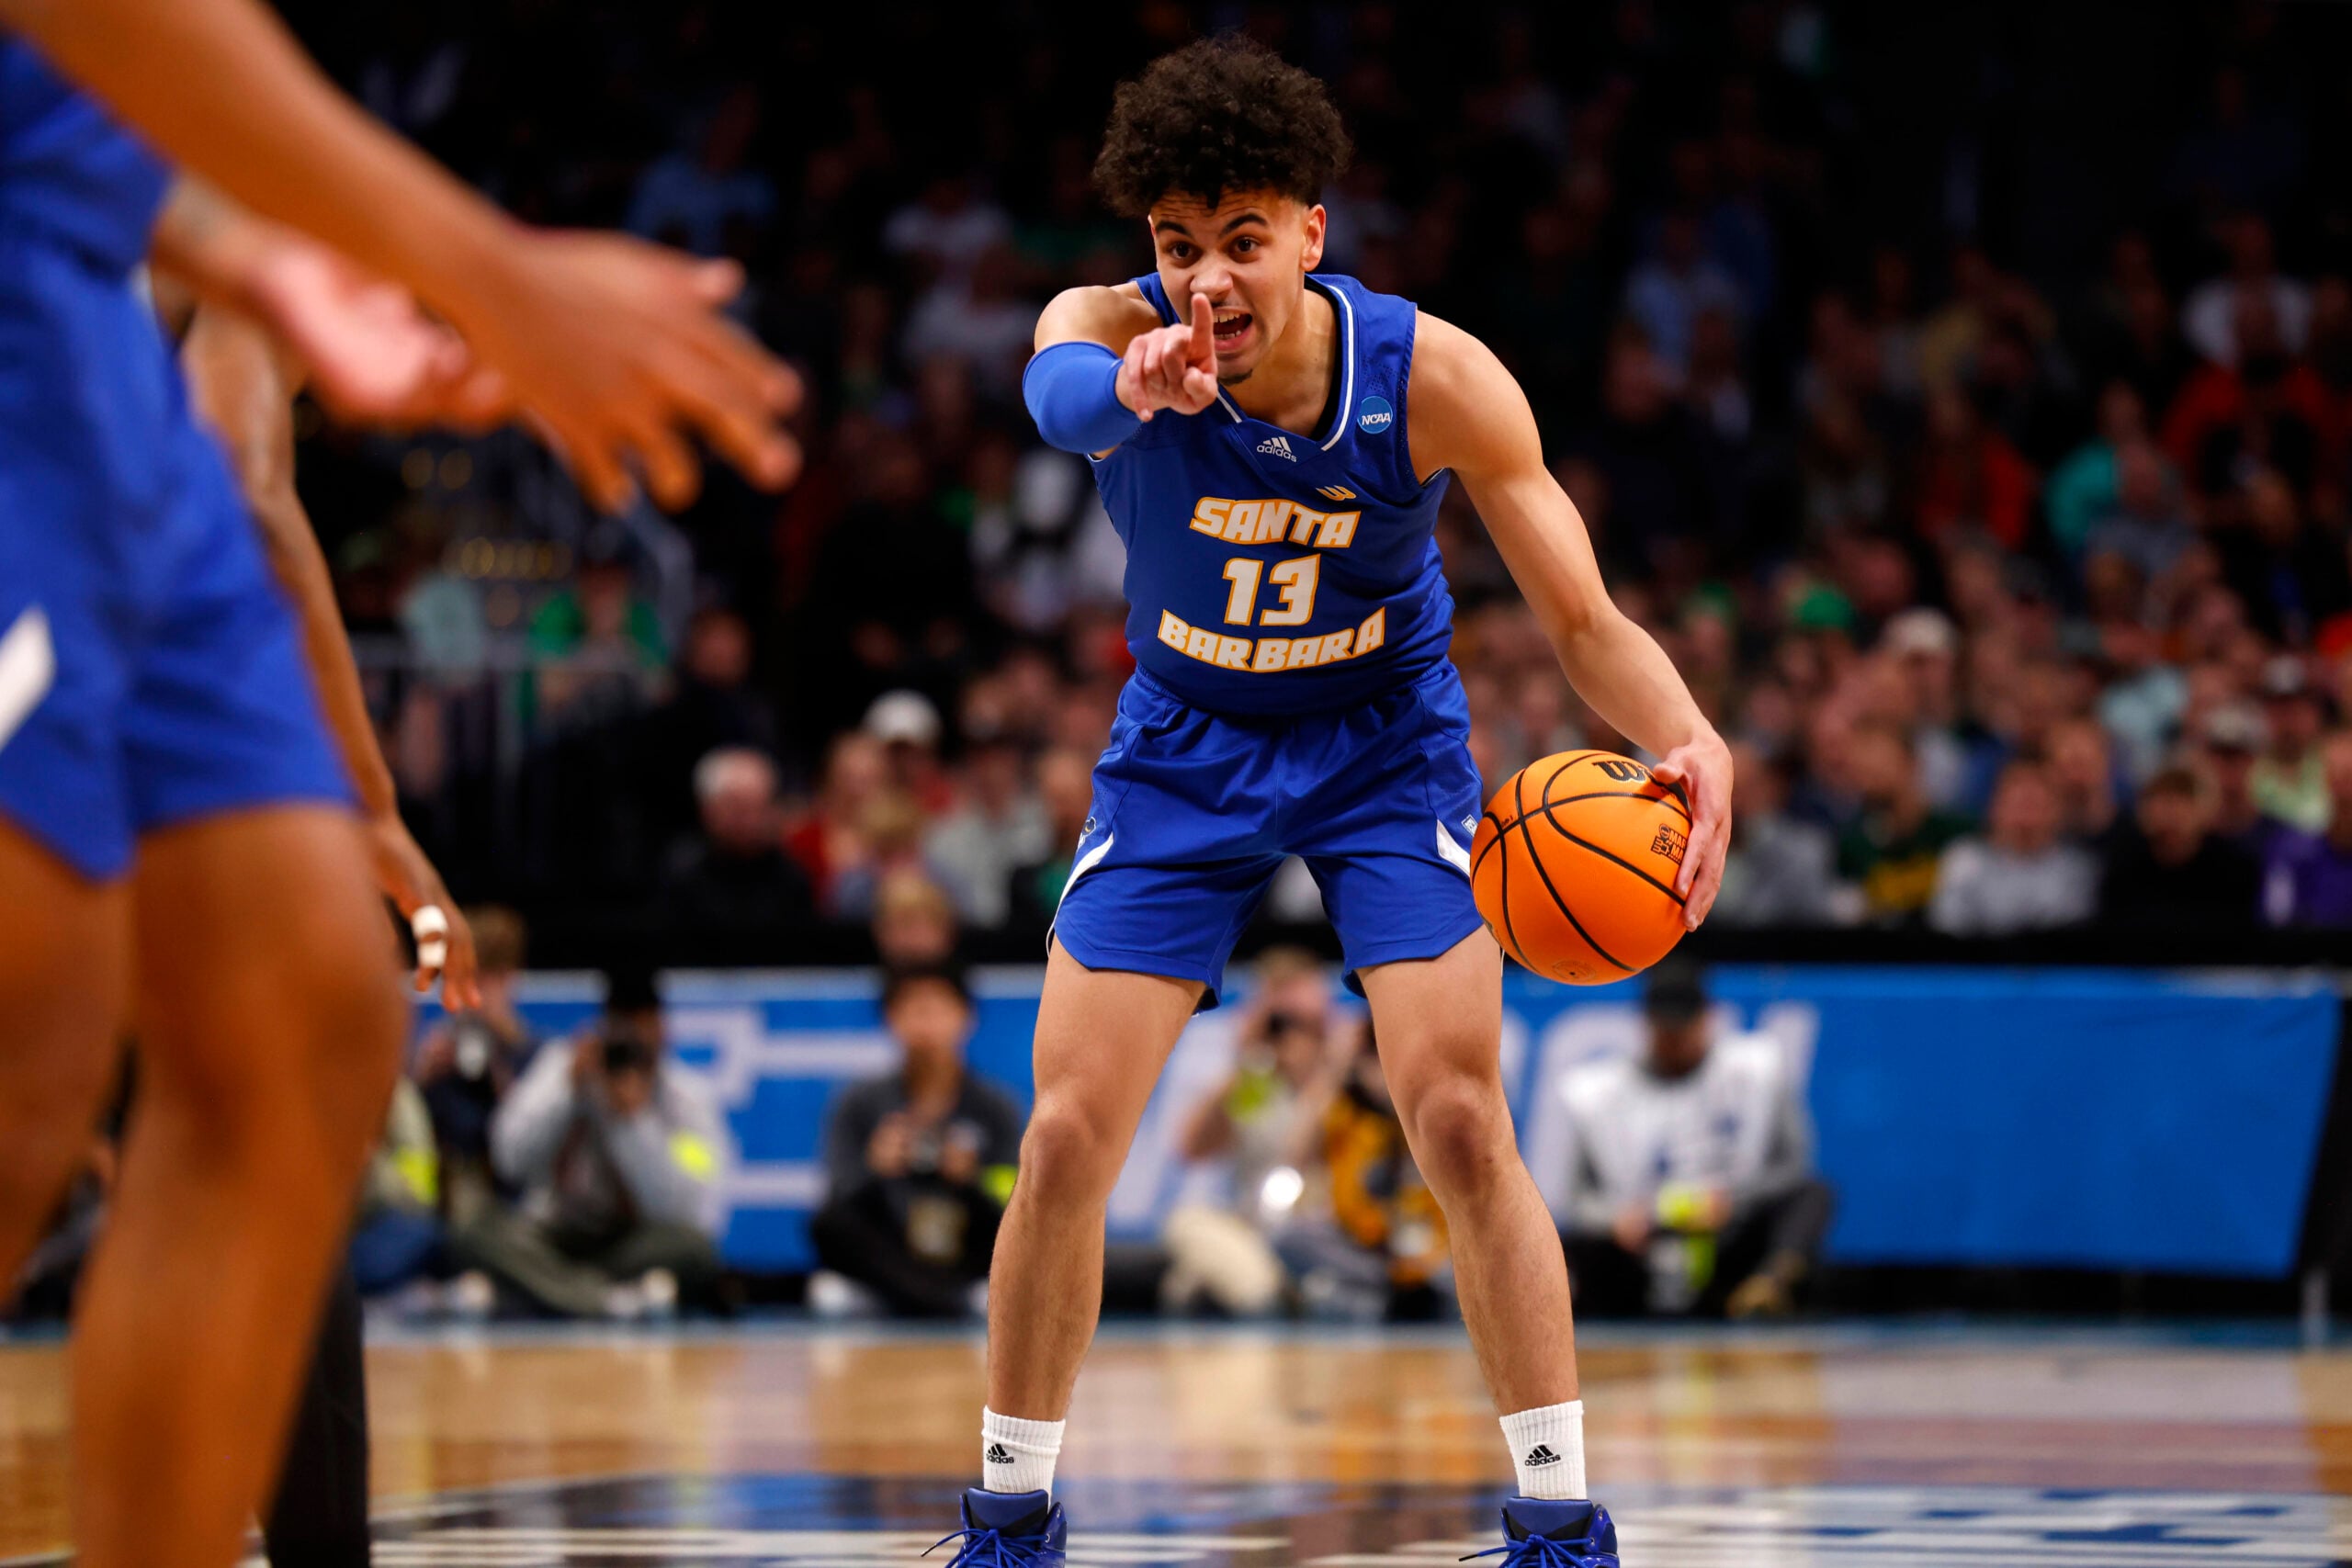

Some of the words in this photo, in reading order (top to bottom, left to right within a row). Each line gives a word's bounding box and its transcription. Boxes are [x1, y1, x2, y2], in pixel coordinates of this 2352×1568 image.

[1362, 412, 1391, 425] NCAA
[1256, 445, 1297, 462] adidas
[1190, 497, 1361, 547] SANTA
[1222, 554, 1321, 626] 13
[1158, 606, 1385, 673] BARBARA
[1525, 1454, 1561, 1467] adidas
